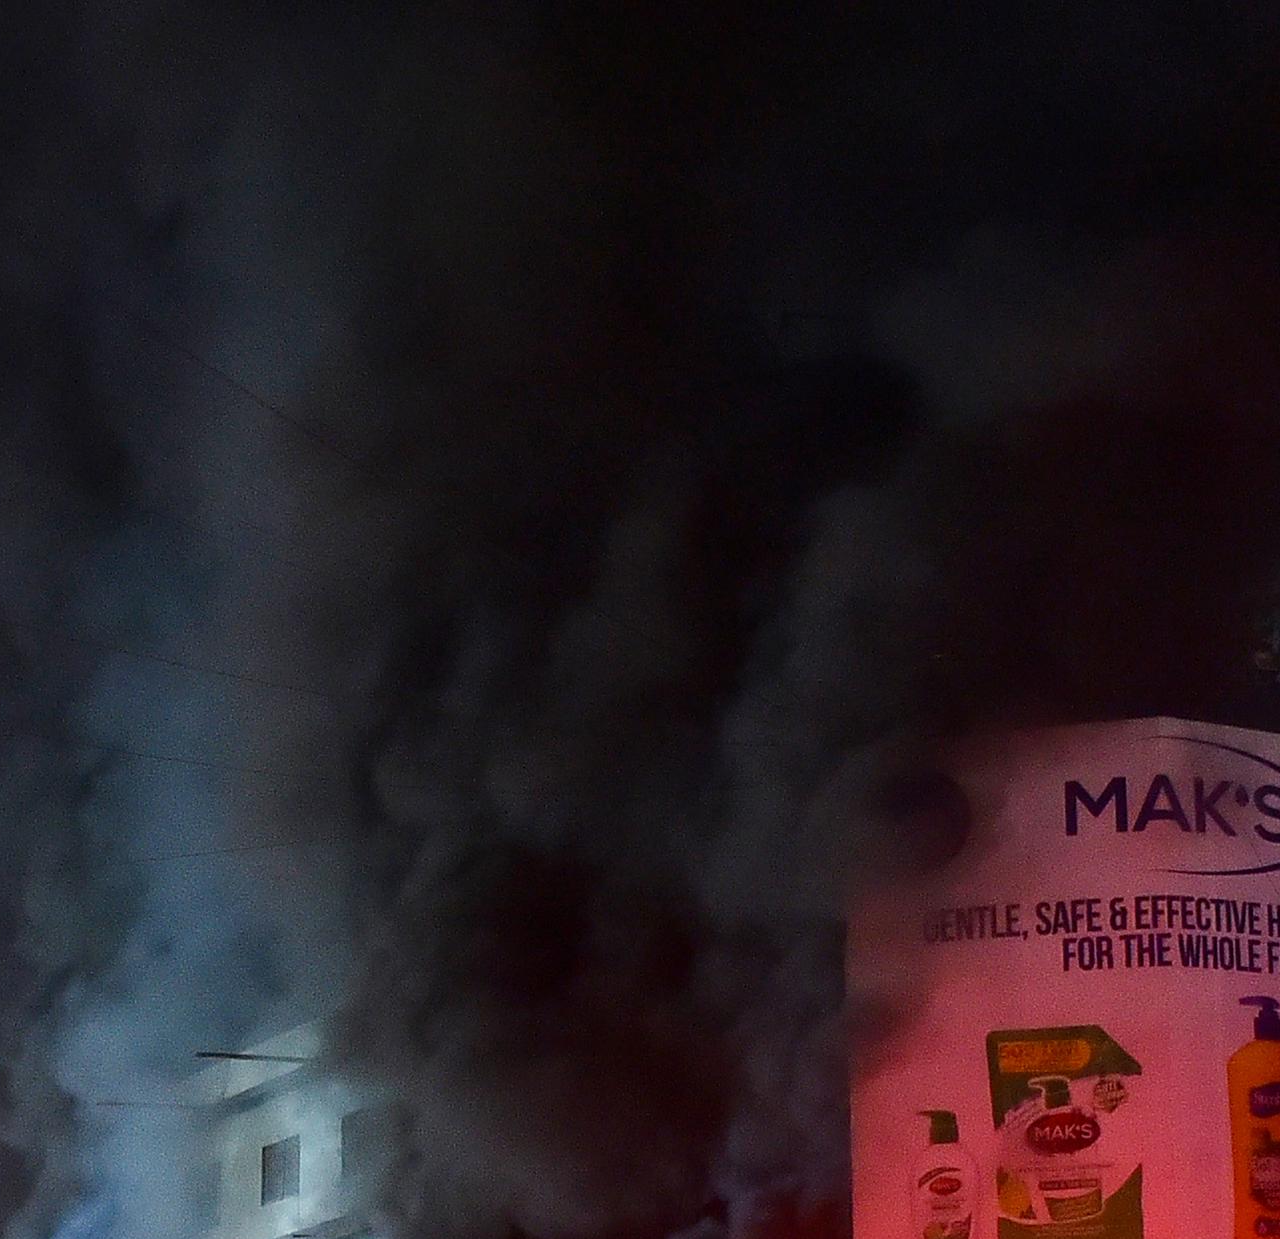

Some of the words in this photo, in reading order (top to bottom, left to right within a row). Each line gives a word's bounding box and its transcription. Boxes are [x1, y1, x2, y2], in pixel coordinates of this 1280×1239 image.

[923, 902, 1029, 943] GENTLE,
[1035, 898, 1101, 935] SAFE
[1110, 897, 1127, 932] &
[1135, 894, 1261, 935] EFFECTIVE
[1063, 934, 1113, 972] FOR
[1120, 933, 1171, 967] THE
[1179, 934, 1261, 973] WHOLE
